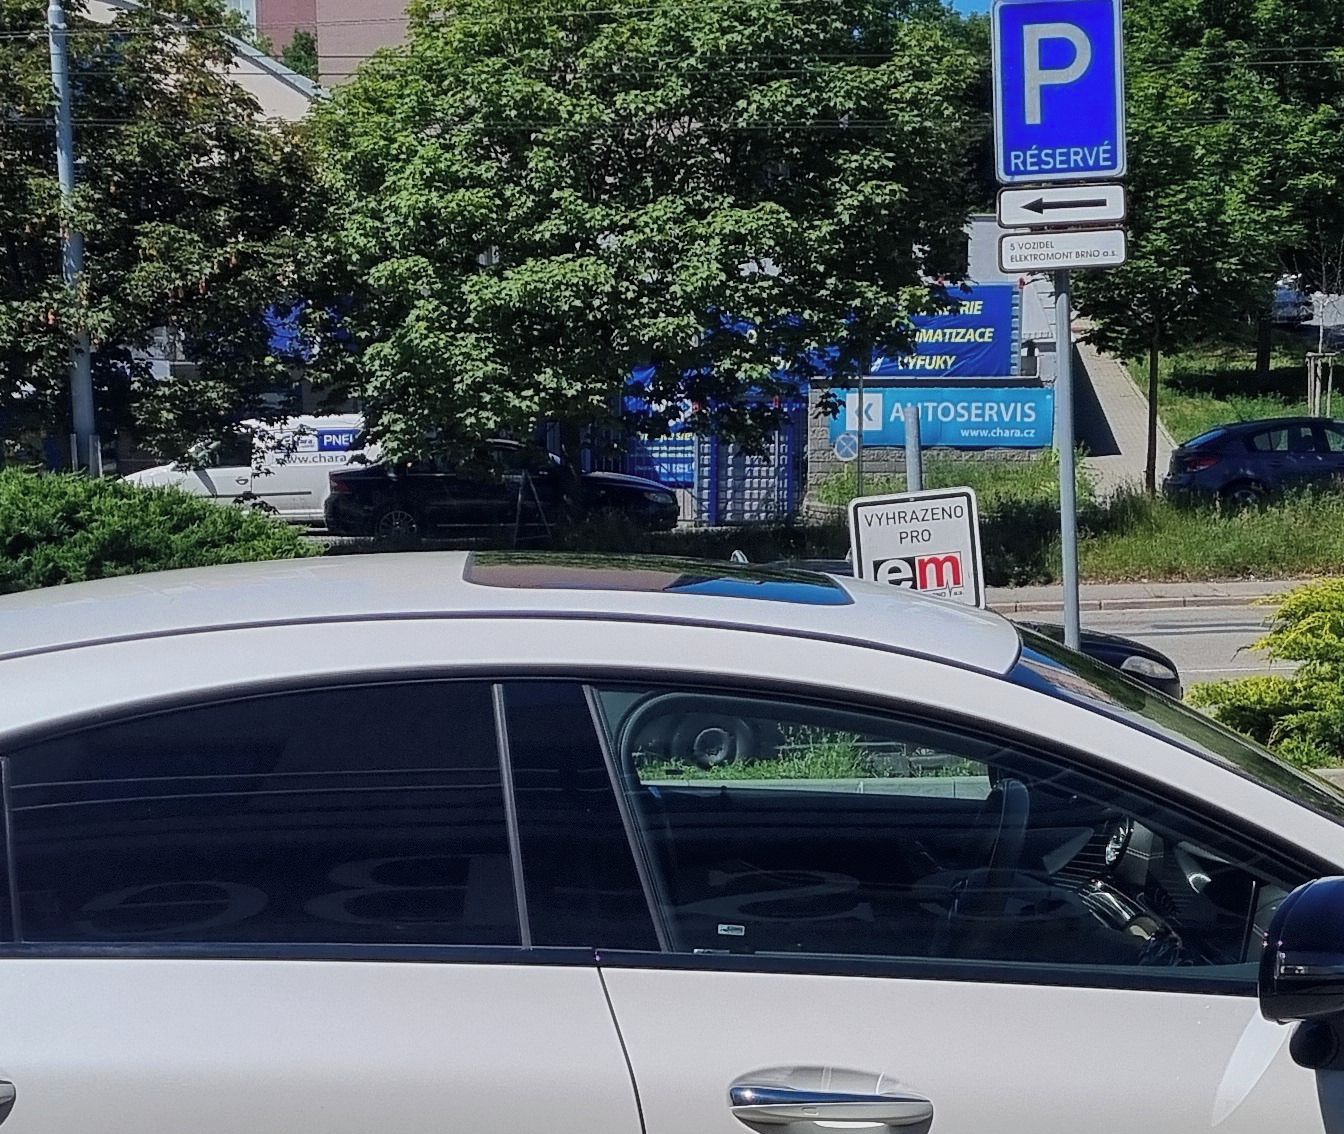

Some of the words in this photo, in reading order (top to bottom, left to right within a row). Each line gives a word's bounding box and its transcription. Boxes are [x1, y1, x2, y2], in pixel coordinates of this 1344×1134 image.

[1023, 23, 1092, 125] P
[1010, 141, 1112, 171] RÉSERVÉ
[1018, 241, 1054, 250] VOZIDEL
[1010, 252, 1072, 263] ELEKTROMONT
[1076, 249, 1100, 259] BRNO
[915, 328, 995, 343] IMATIZACE
[889, 402, 1036, 423] ATOSERVIS
[960, 427, 1035, 438] www.chara.cz
[863, 505, 964, 527] VYHRAZENO
[898, 528, 932, 545] PRO
[876, 553, 962, 590] em
